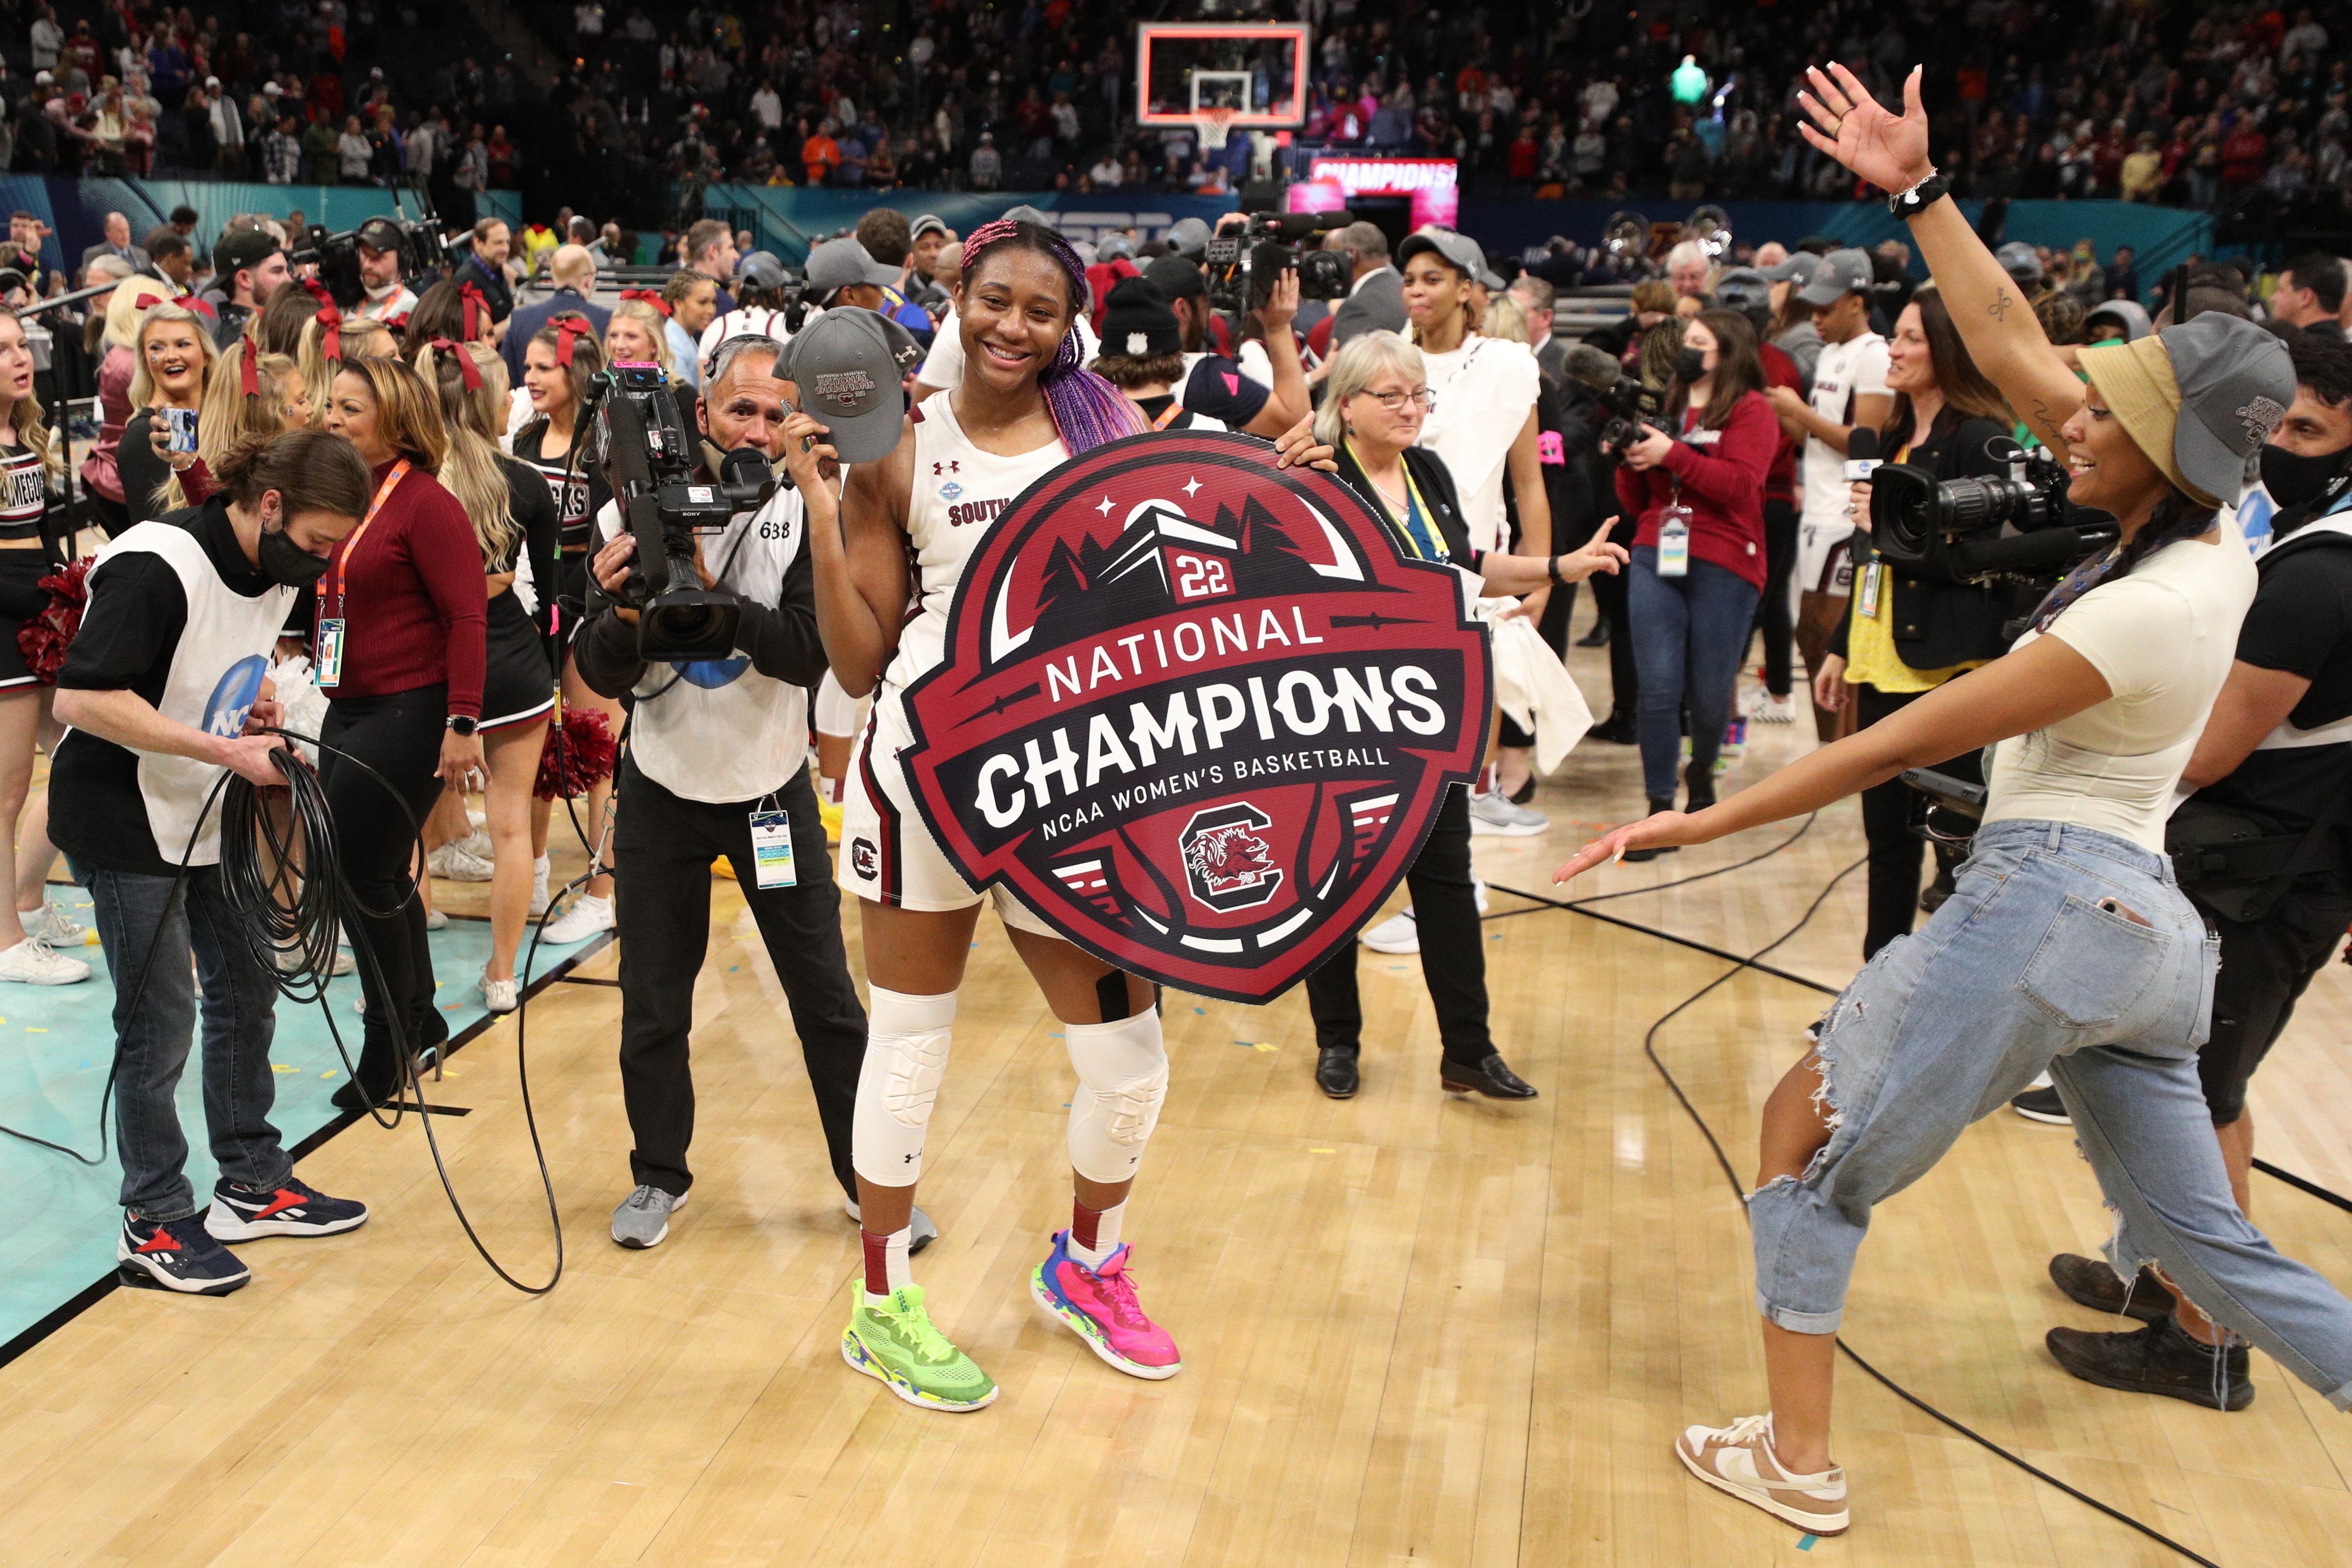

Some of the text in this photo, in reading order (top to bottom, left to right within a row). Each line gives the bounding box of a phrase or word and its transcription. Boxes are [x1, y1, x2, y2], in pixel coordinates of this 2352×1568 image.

[815, 381, 875, 395] CHAMPIONS
[818, 374, 868, 386] NATIONAL
[1176, 555, 1228, 597] 22
[1046, 606, 1323, 702] NATIONAL
[974, 665, 1445, 828] CHAMPIONS
[1042, 748, 1389, 841] NCAA WOMEN'S BASKETBALL
